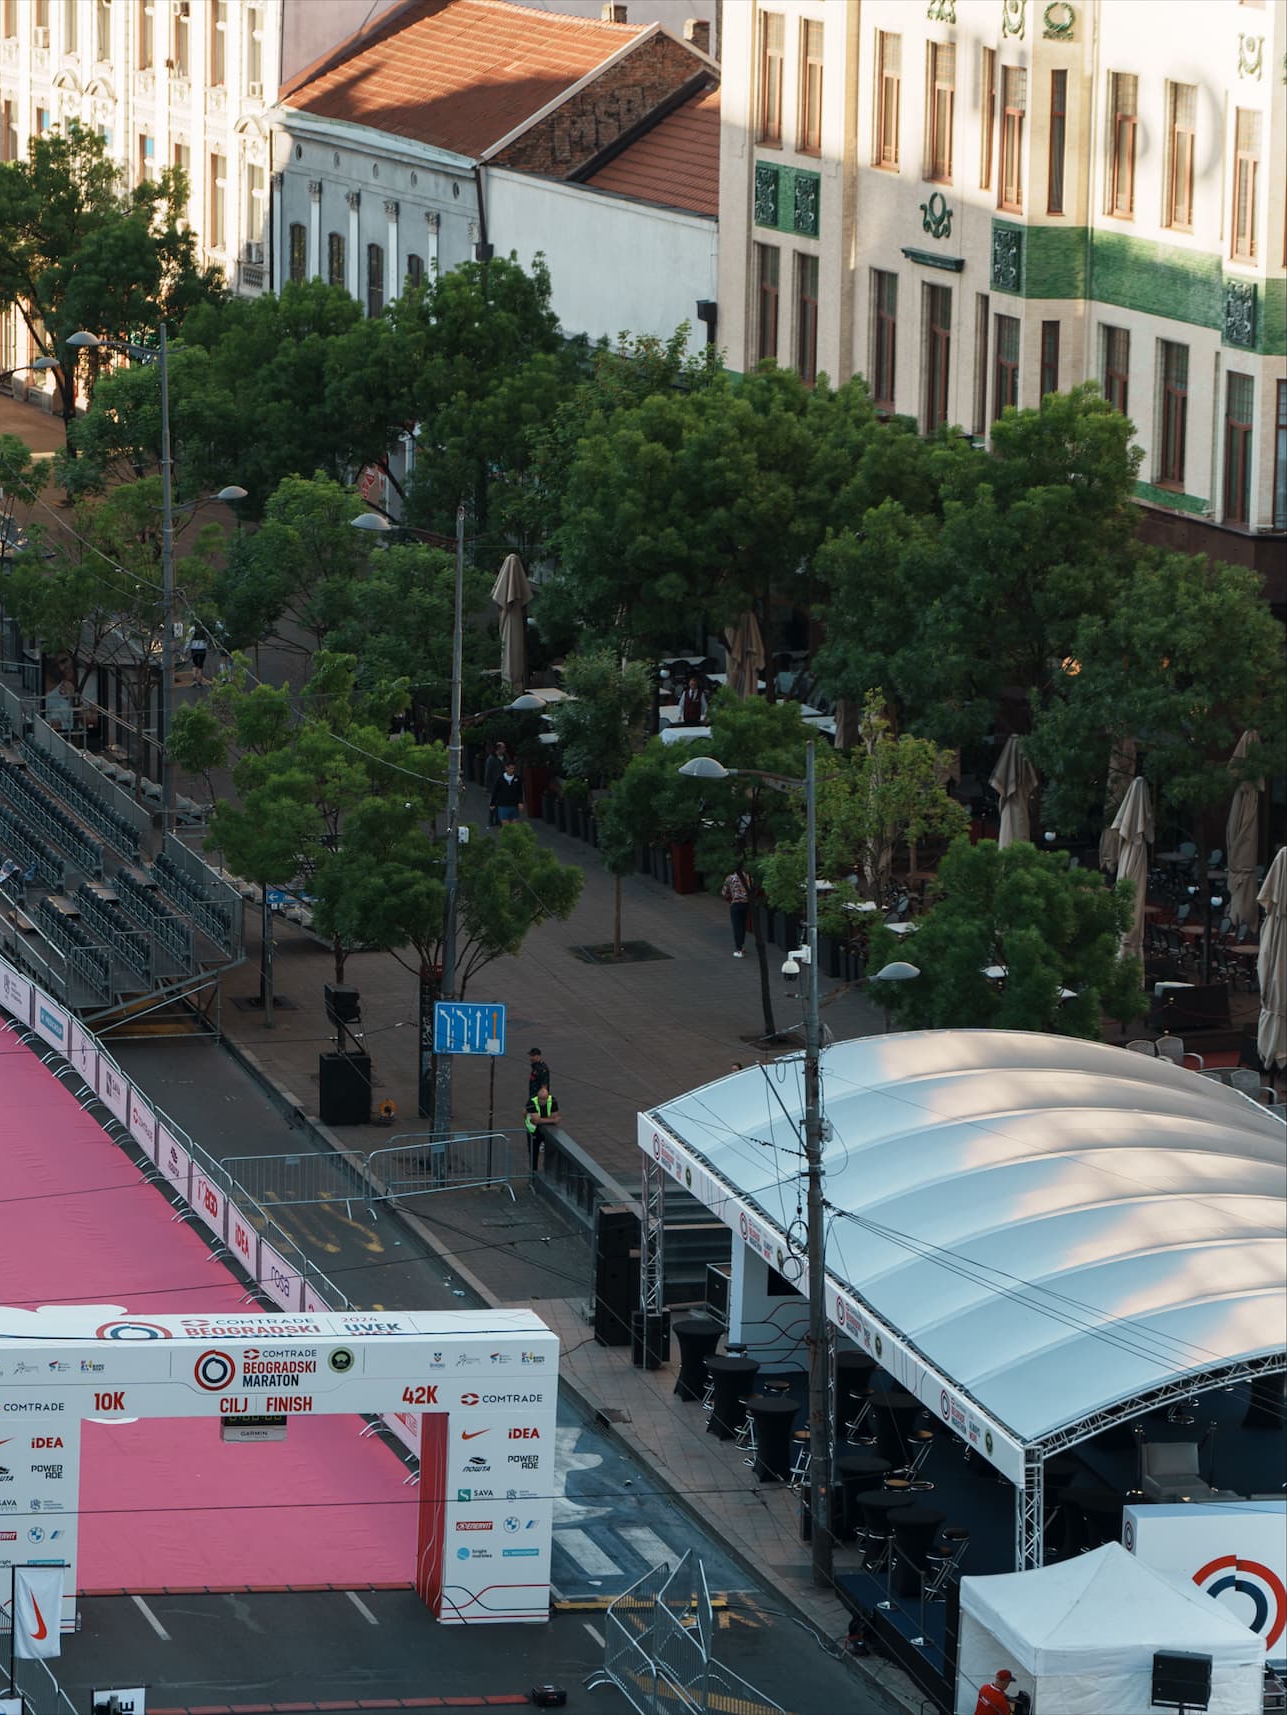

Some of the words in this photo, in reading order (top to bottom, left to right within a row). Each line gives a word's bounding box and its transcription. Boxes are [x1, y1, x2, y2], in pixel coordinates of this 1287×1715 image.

[216, 1317, 315, 1325] COMTRADE
[184, 1325, 322, 1338] BEOGRADSKI
[345, 1323, 402, 1332] UVEK
[262, 1349, 317, 1358] COMTRADE
[242, 1360, 317, 1375] BEOGRADSKI
[242, 1374, 299, 1387] MARATON
[402, 1385, 439, 1404] 42K
[482, 1394, 543, 1404] COMTRADE
[94, 1391, 126, 1411] 10K
[219, 1397, 249, 1413] CILJ
[265, 1396, 313, 1412] FINISH
[3, 1402, 65, 1412] COMTRADE
[507, 1455, 539, 1464] POWER
[31, 1464, 63, 1473] POWER
[473, 1489, 494, 1497] SAVA
